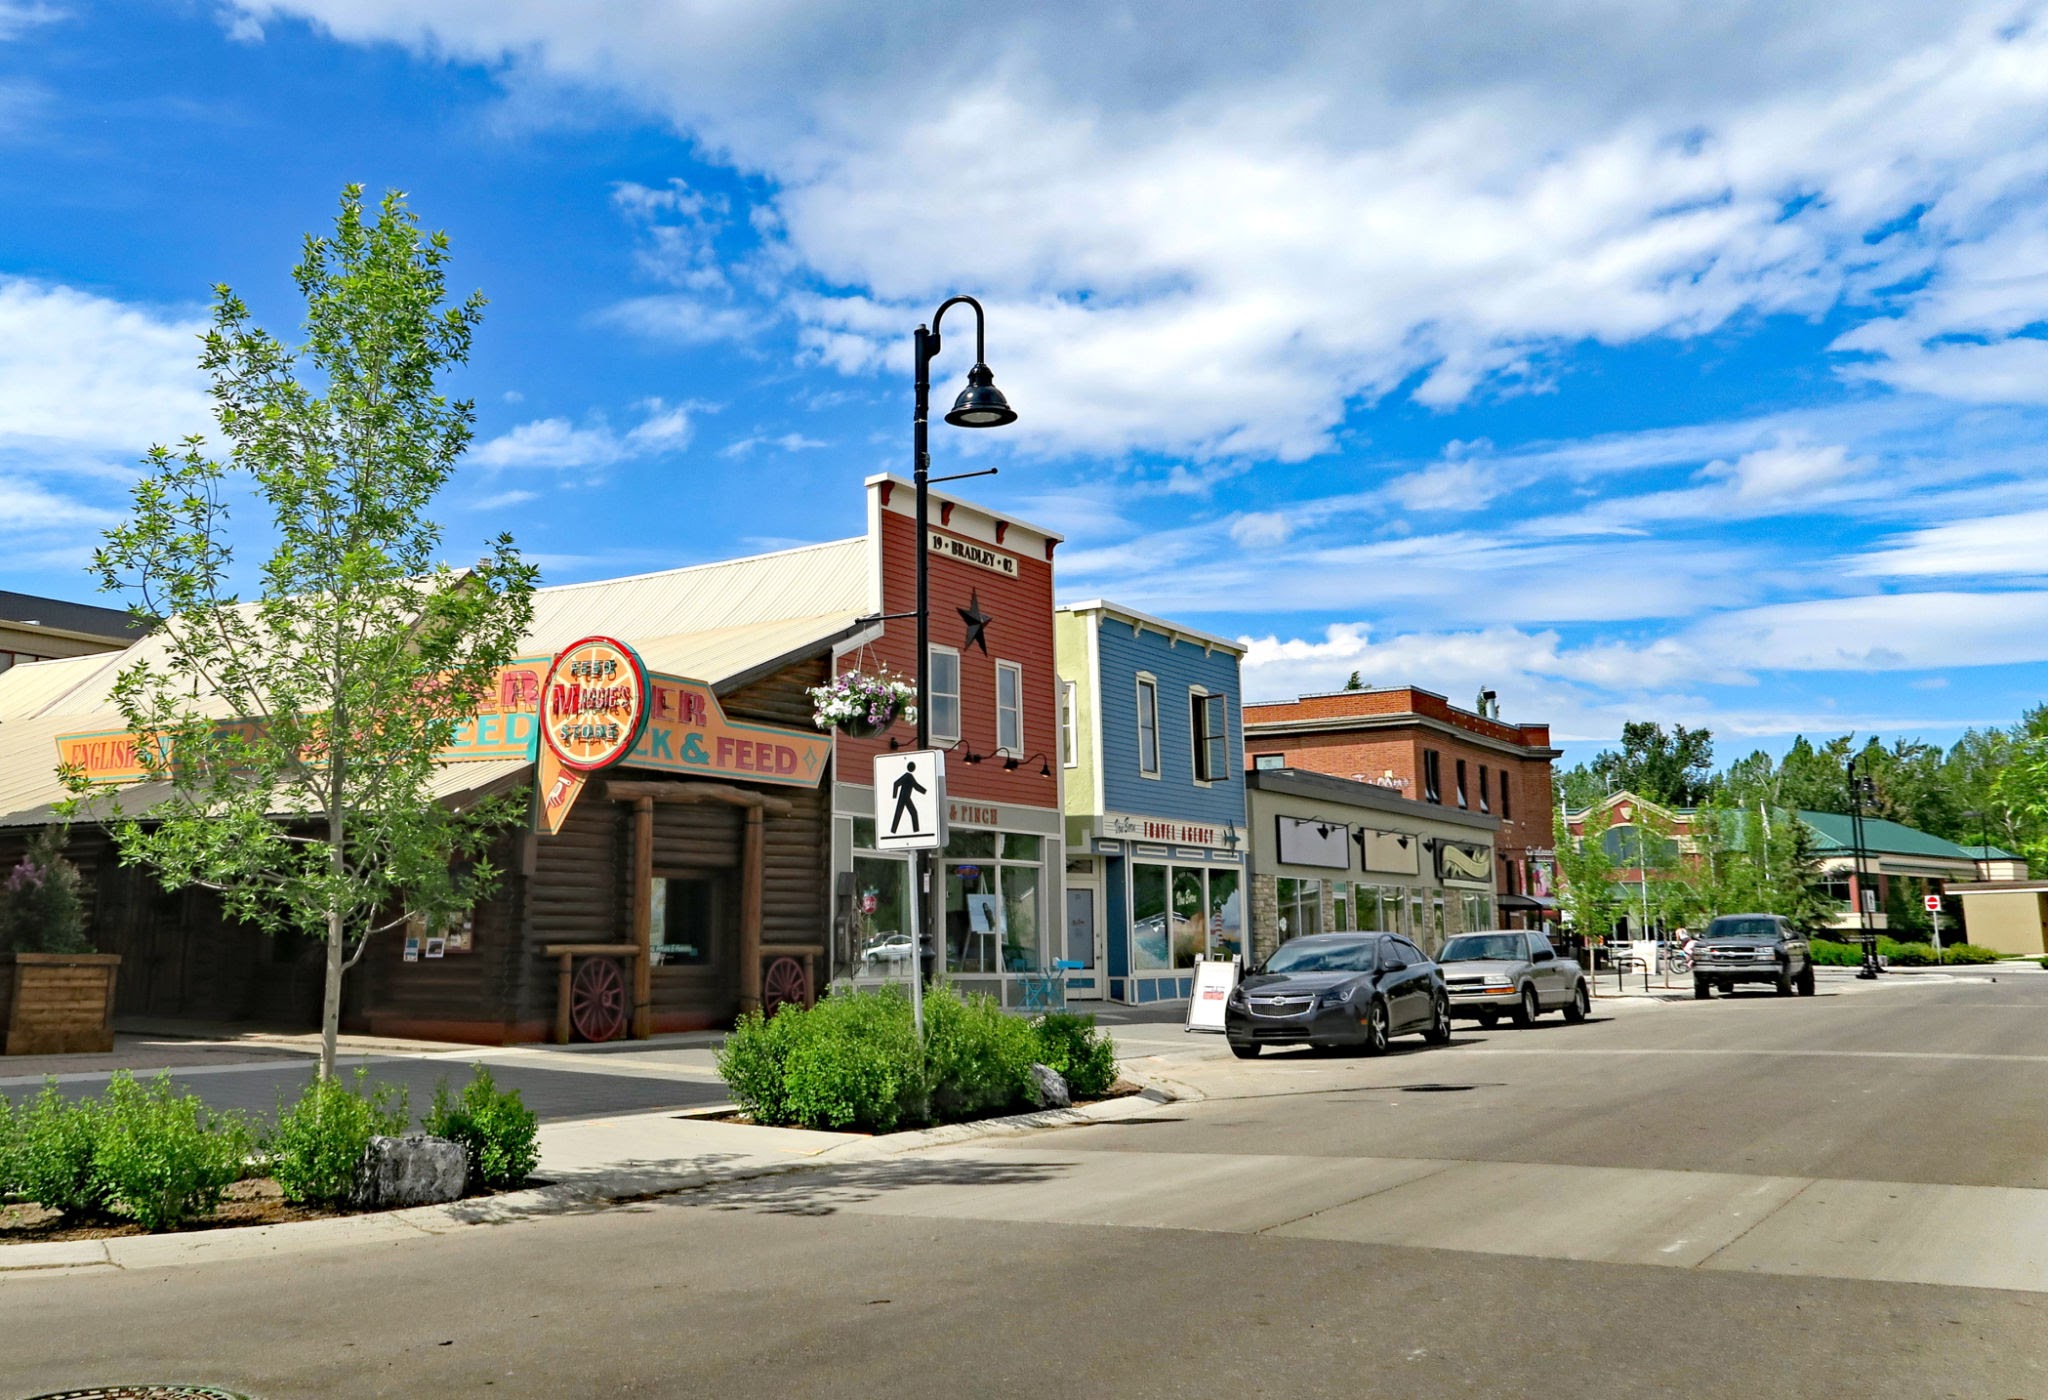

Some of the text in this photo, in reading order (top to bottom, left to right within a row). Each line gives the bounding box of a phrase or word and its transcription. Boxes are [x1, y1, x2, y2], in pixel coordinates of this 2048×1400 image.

[933, 535, 943, 550] 19
[951, 540, 996, 568] BRADLEY
[571, 659, 617, 676] FEED
[560, 722, 619, 741] STORE
[680, 732, 710, 765] &
[716, 736, 798, 775] FEED
